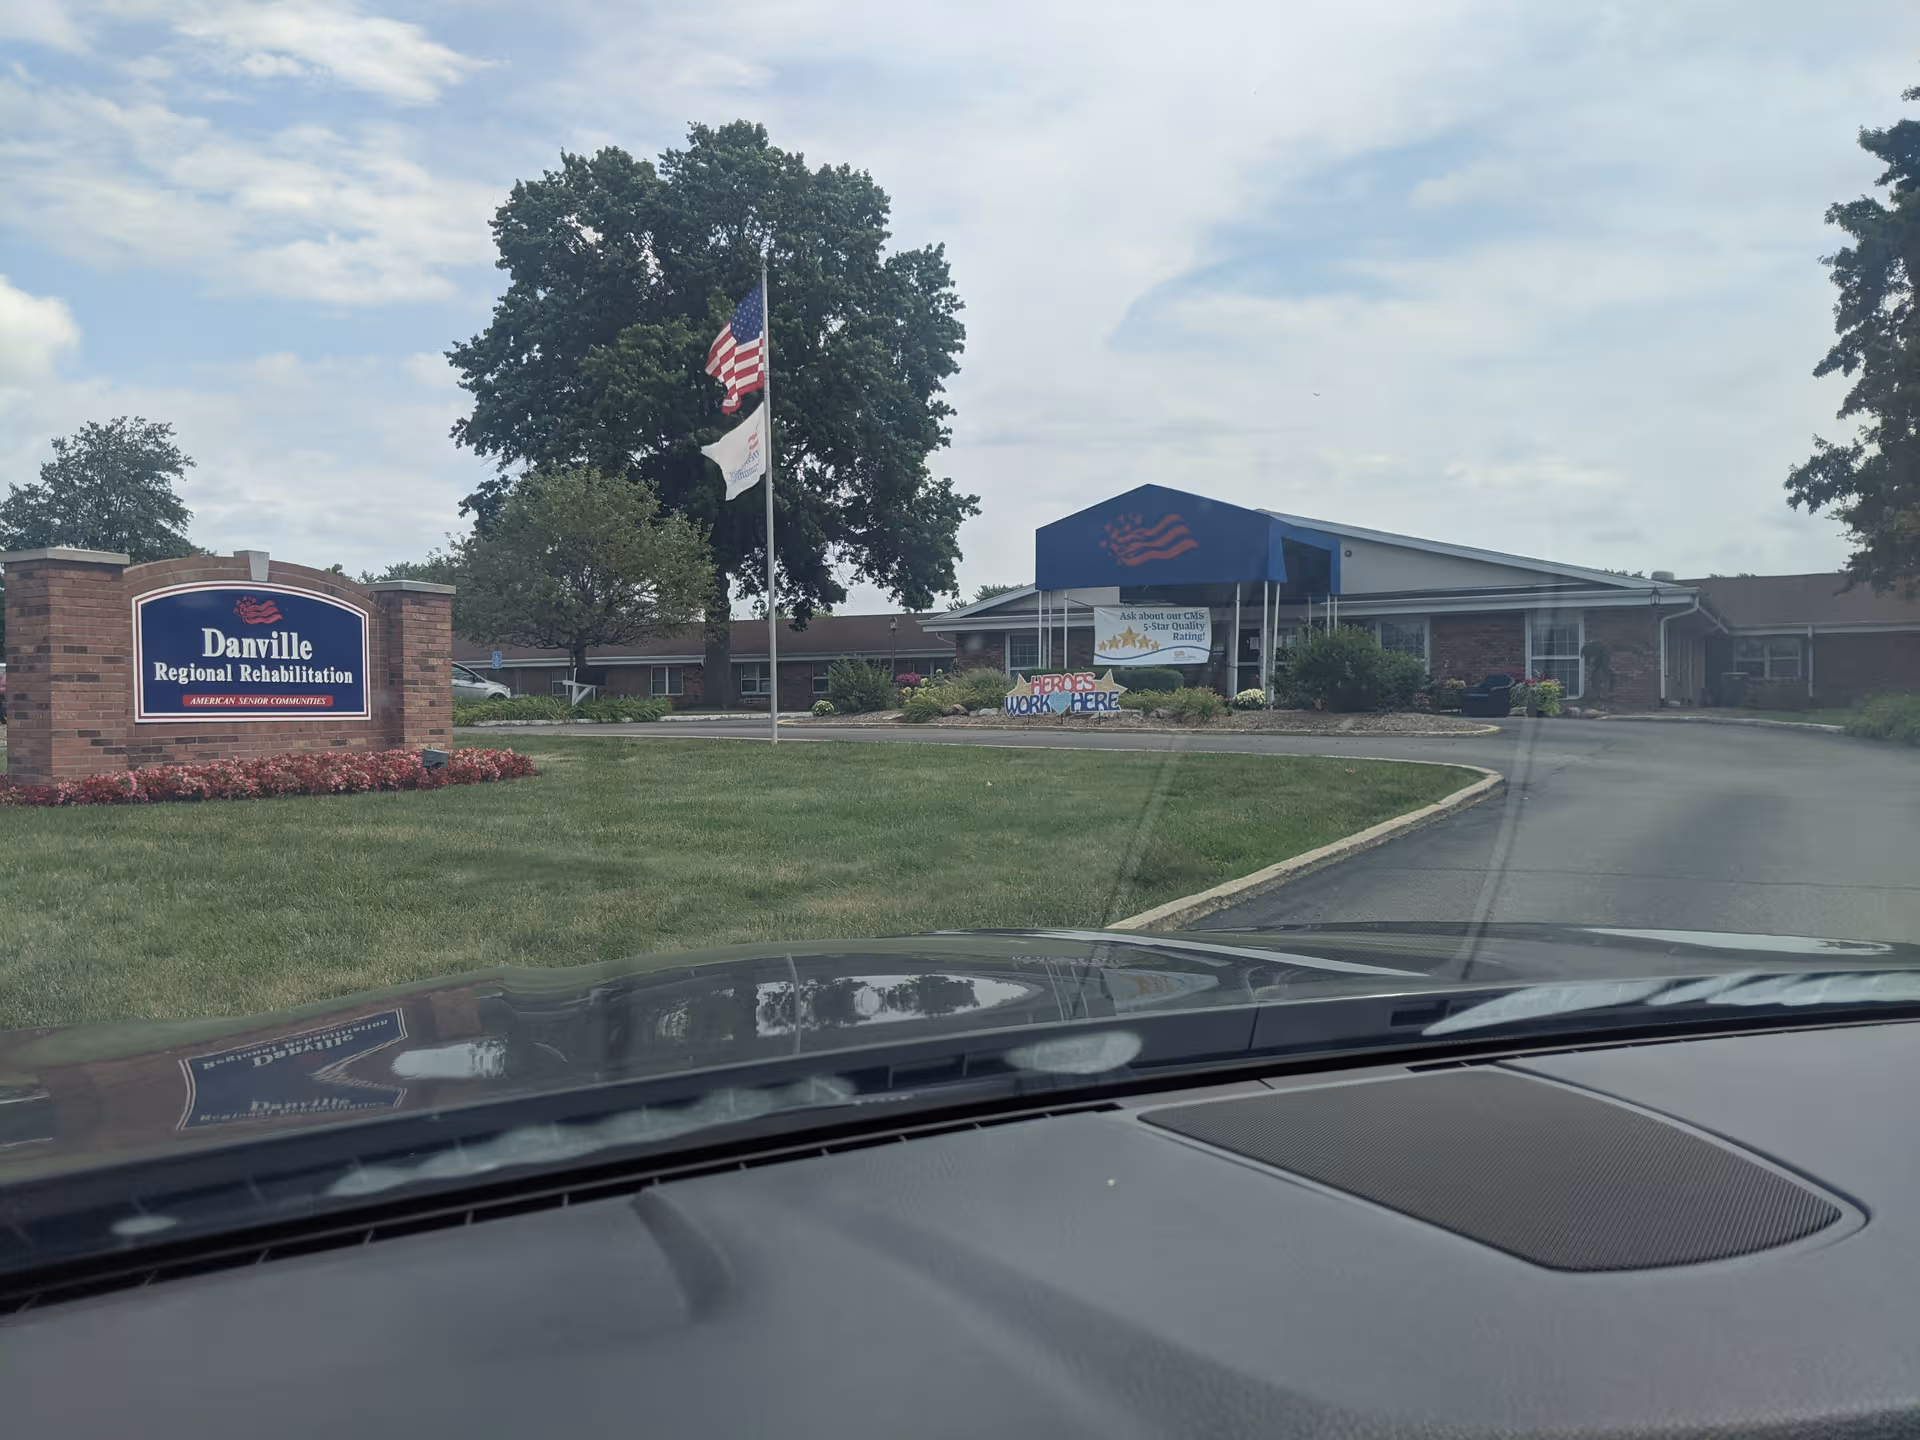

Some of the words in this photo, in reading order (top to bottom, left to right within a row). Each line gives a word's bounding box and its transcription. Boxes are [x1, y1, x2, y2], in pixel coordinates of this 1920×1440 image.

[1120, 612, 1137, 620] Ask
[1138, 612, 1165, 620] about
[1183, 612, 1205, 620] CMS
[1143, 622, 1170, 631] 5-Star
[1171, 622, 1205, 631] Quality
[201, 628, 312, 660] Danville
[1172, 632, 1206, 642] Rating!
[154, 662, 233, 684] Regional
[239, 664, 353, 684] Rehabilitation
[1030, 672, 1096, 695] HEROES
[190, 696, 236, 705] AMERICAN
[238, 696, 268, 705] SENIOR
[270, 696, 326, 705] COMMUNITIES
[1004, 695, 1051, 717] WORK
[1070, 691, 1121, 712] HERE
